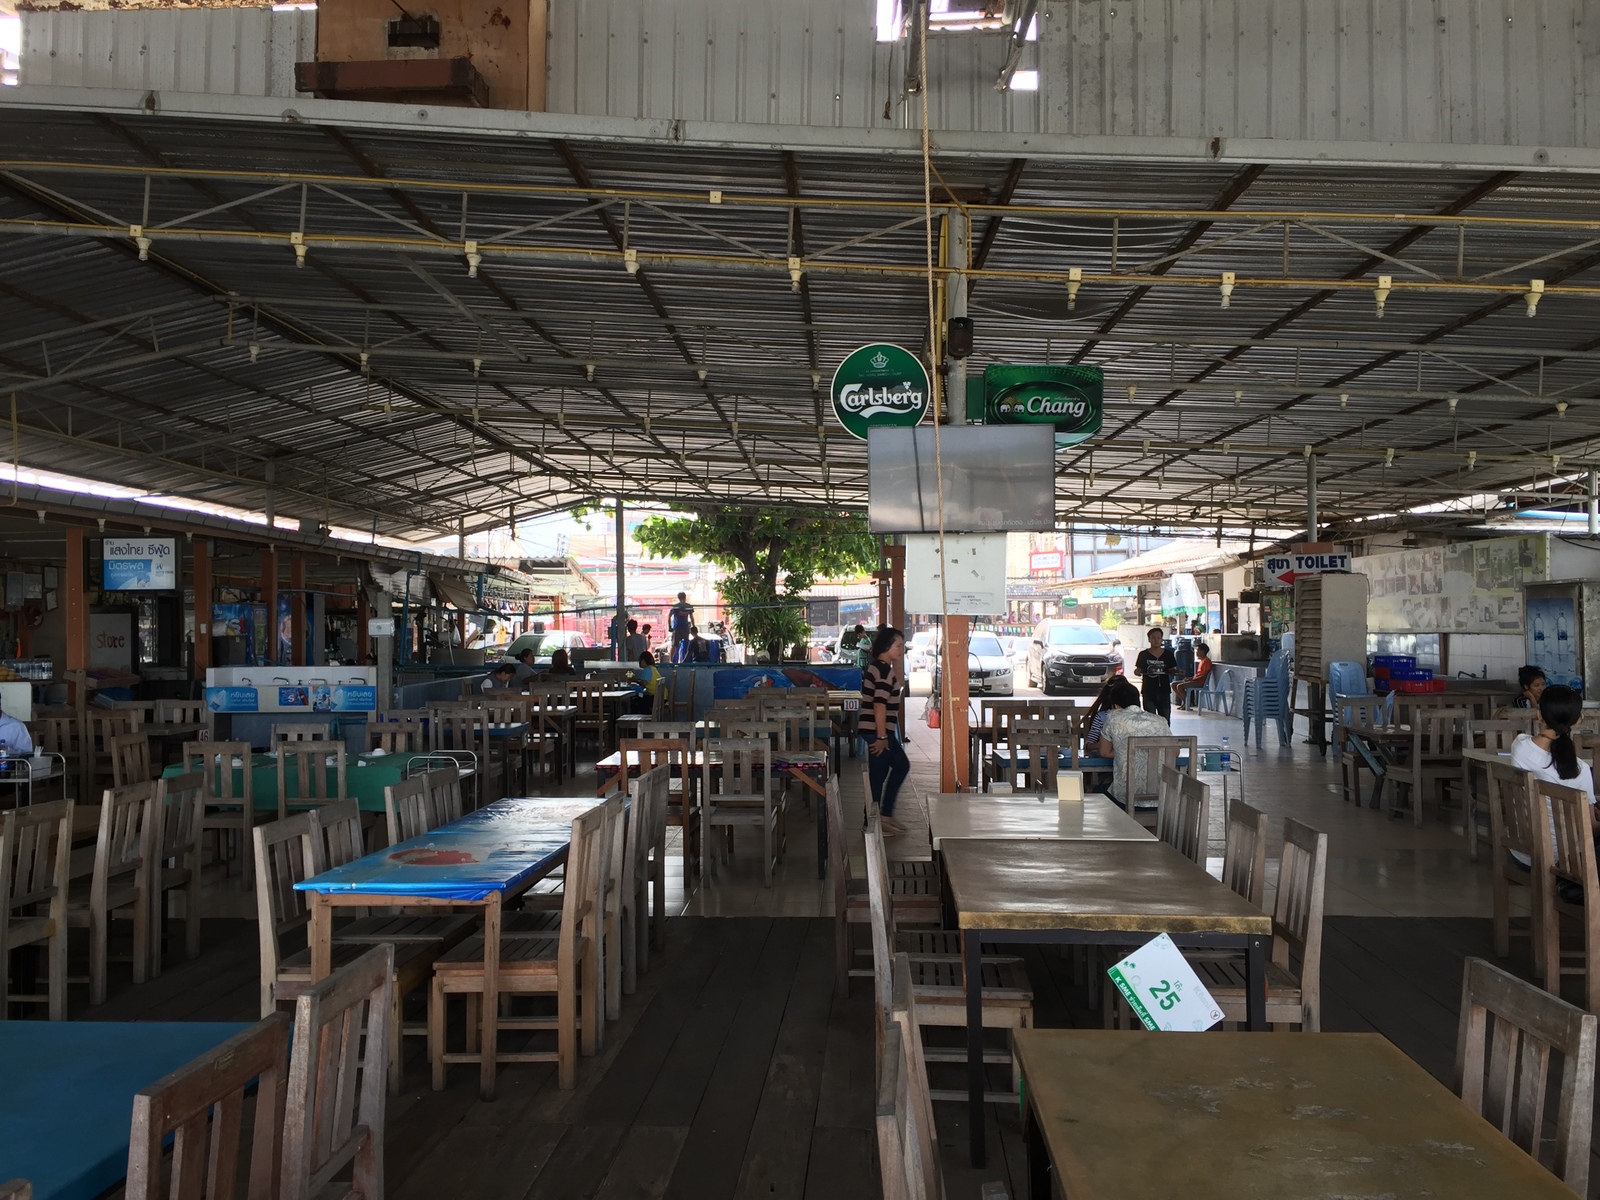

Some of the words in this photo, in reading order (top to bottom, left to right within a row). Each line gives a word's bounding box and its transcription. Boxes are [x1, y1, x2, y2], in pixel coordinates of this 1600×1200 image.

[840, 382, 923, 413] Carlsberg
[1026, 395, 1086, 418] Chang
[109, 543, 144, 556] แสงไทย
[108, 561, 144, 570] มิตรผล
[1267, 557, 1290, 574] สุขา
[1296, 555, 1347, 569] TOILET
[845, 700, 858, 710] 101
[200, 730, 209, 742] 46
[1115, 976, 1122, 984] K
[1119, 982, 1132, 997] SME
[1143, 1016, 1156, 1031] SME
[1149, 980, 1181, 1011] 25
